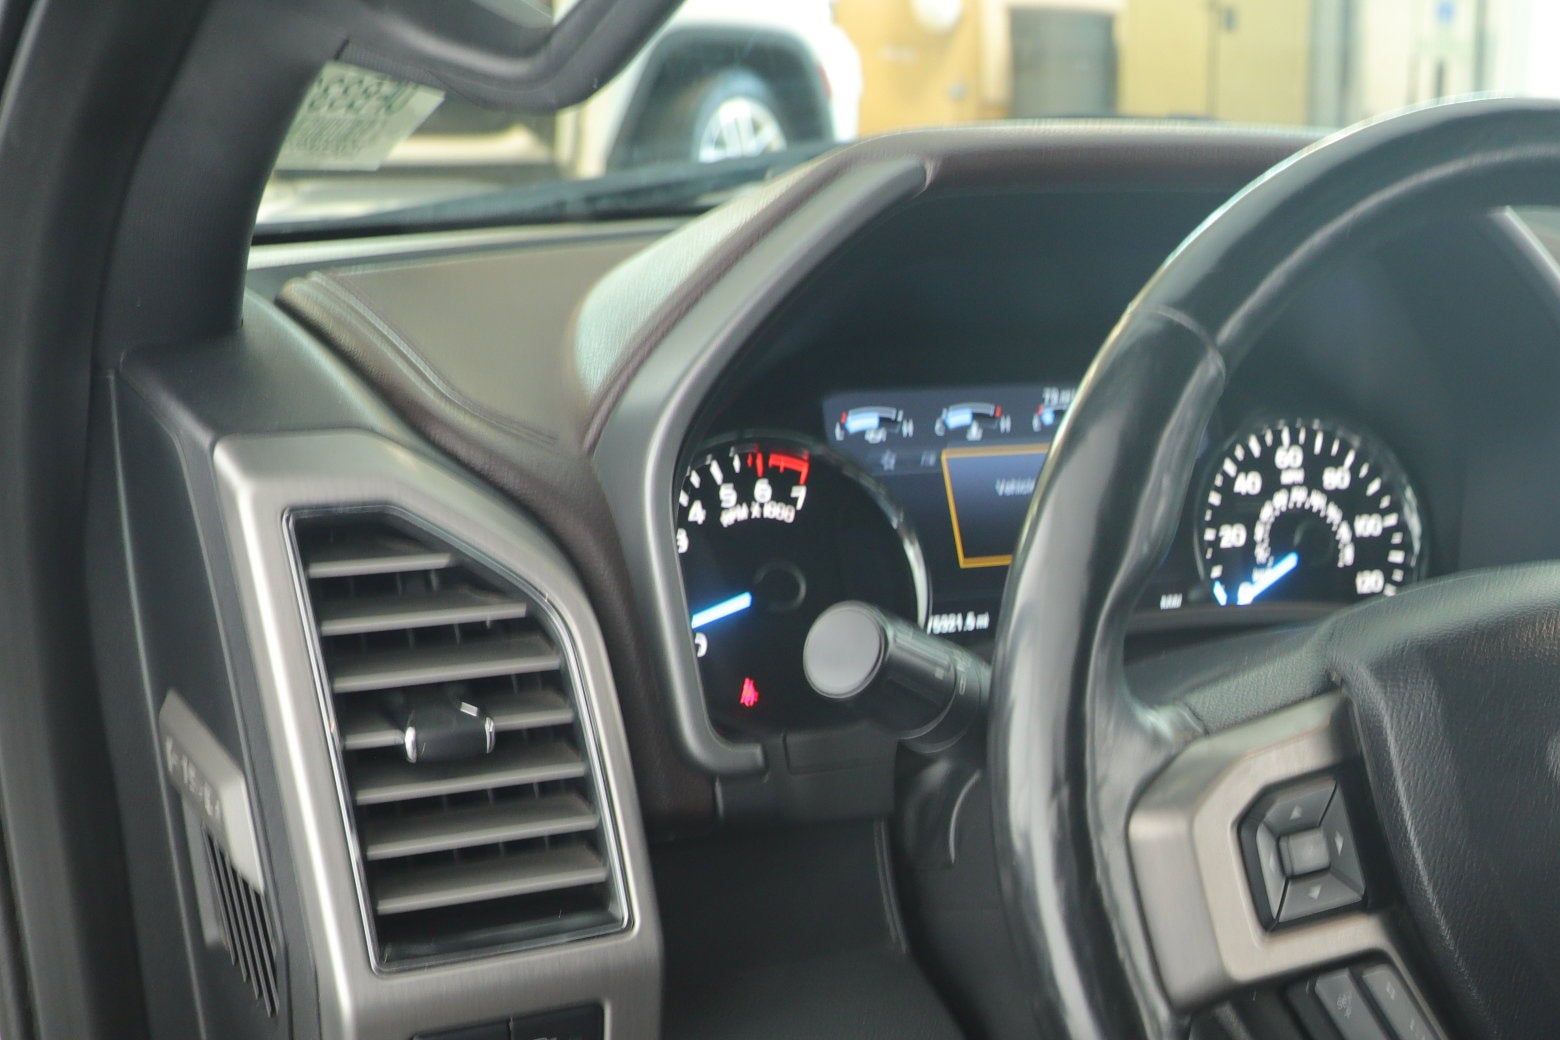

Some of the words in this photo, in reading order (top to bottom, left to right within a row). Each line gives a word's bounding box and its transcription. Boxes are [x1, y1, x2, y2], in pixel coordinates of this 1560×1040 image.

[1275, 444, 1304, 470] 60
[754, 478, 772, 503] 6
[1233, 471, 1262, 495] 40
[1322, 466, 1351, 491] 80
[719, 482, 737, 508] 5
[790, 485, 807, 510] 7
[688, 500, 706, 525] 4
[1219, 523, 1247, 549] 20
[1353, 513, 1384, 538] 100
[676, 527, 689, 554] 3
[1355, 568, 1385, 594] 120
